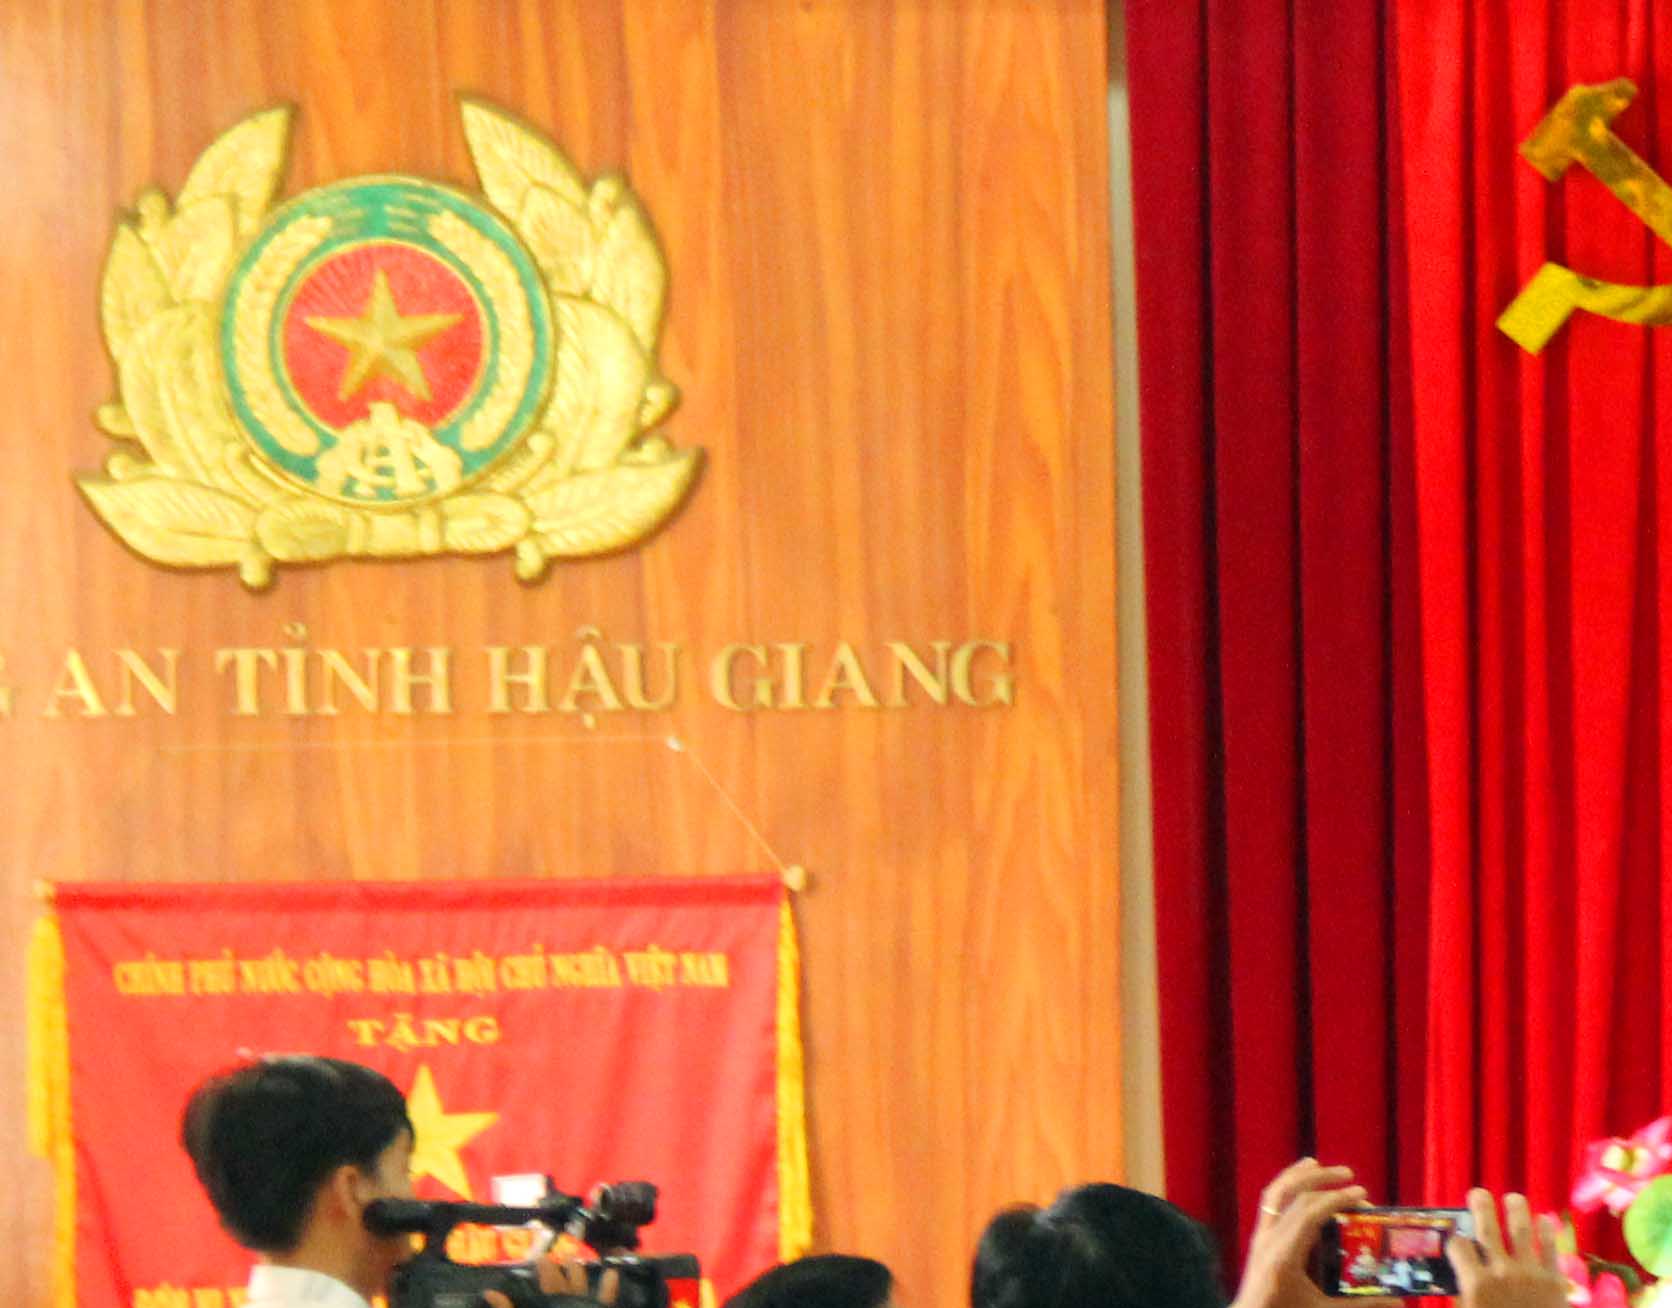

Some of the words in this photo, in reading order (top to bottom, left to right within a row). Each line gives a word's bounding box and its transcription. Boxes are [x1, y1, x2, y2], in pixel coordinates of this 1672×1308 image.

[43, 646, 182, 719] AN
[214, 621, 454, 717] TỈNH
[484, 624, 682, 729] HẬU
[709, 638, 1016, 711] GIANG
[346, 1012, 502, 1052] TẶNG
